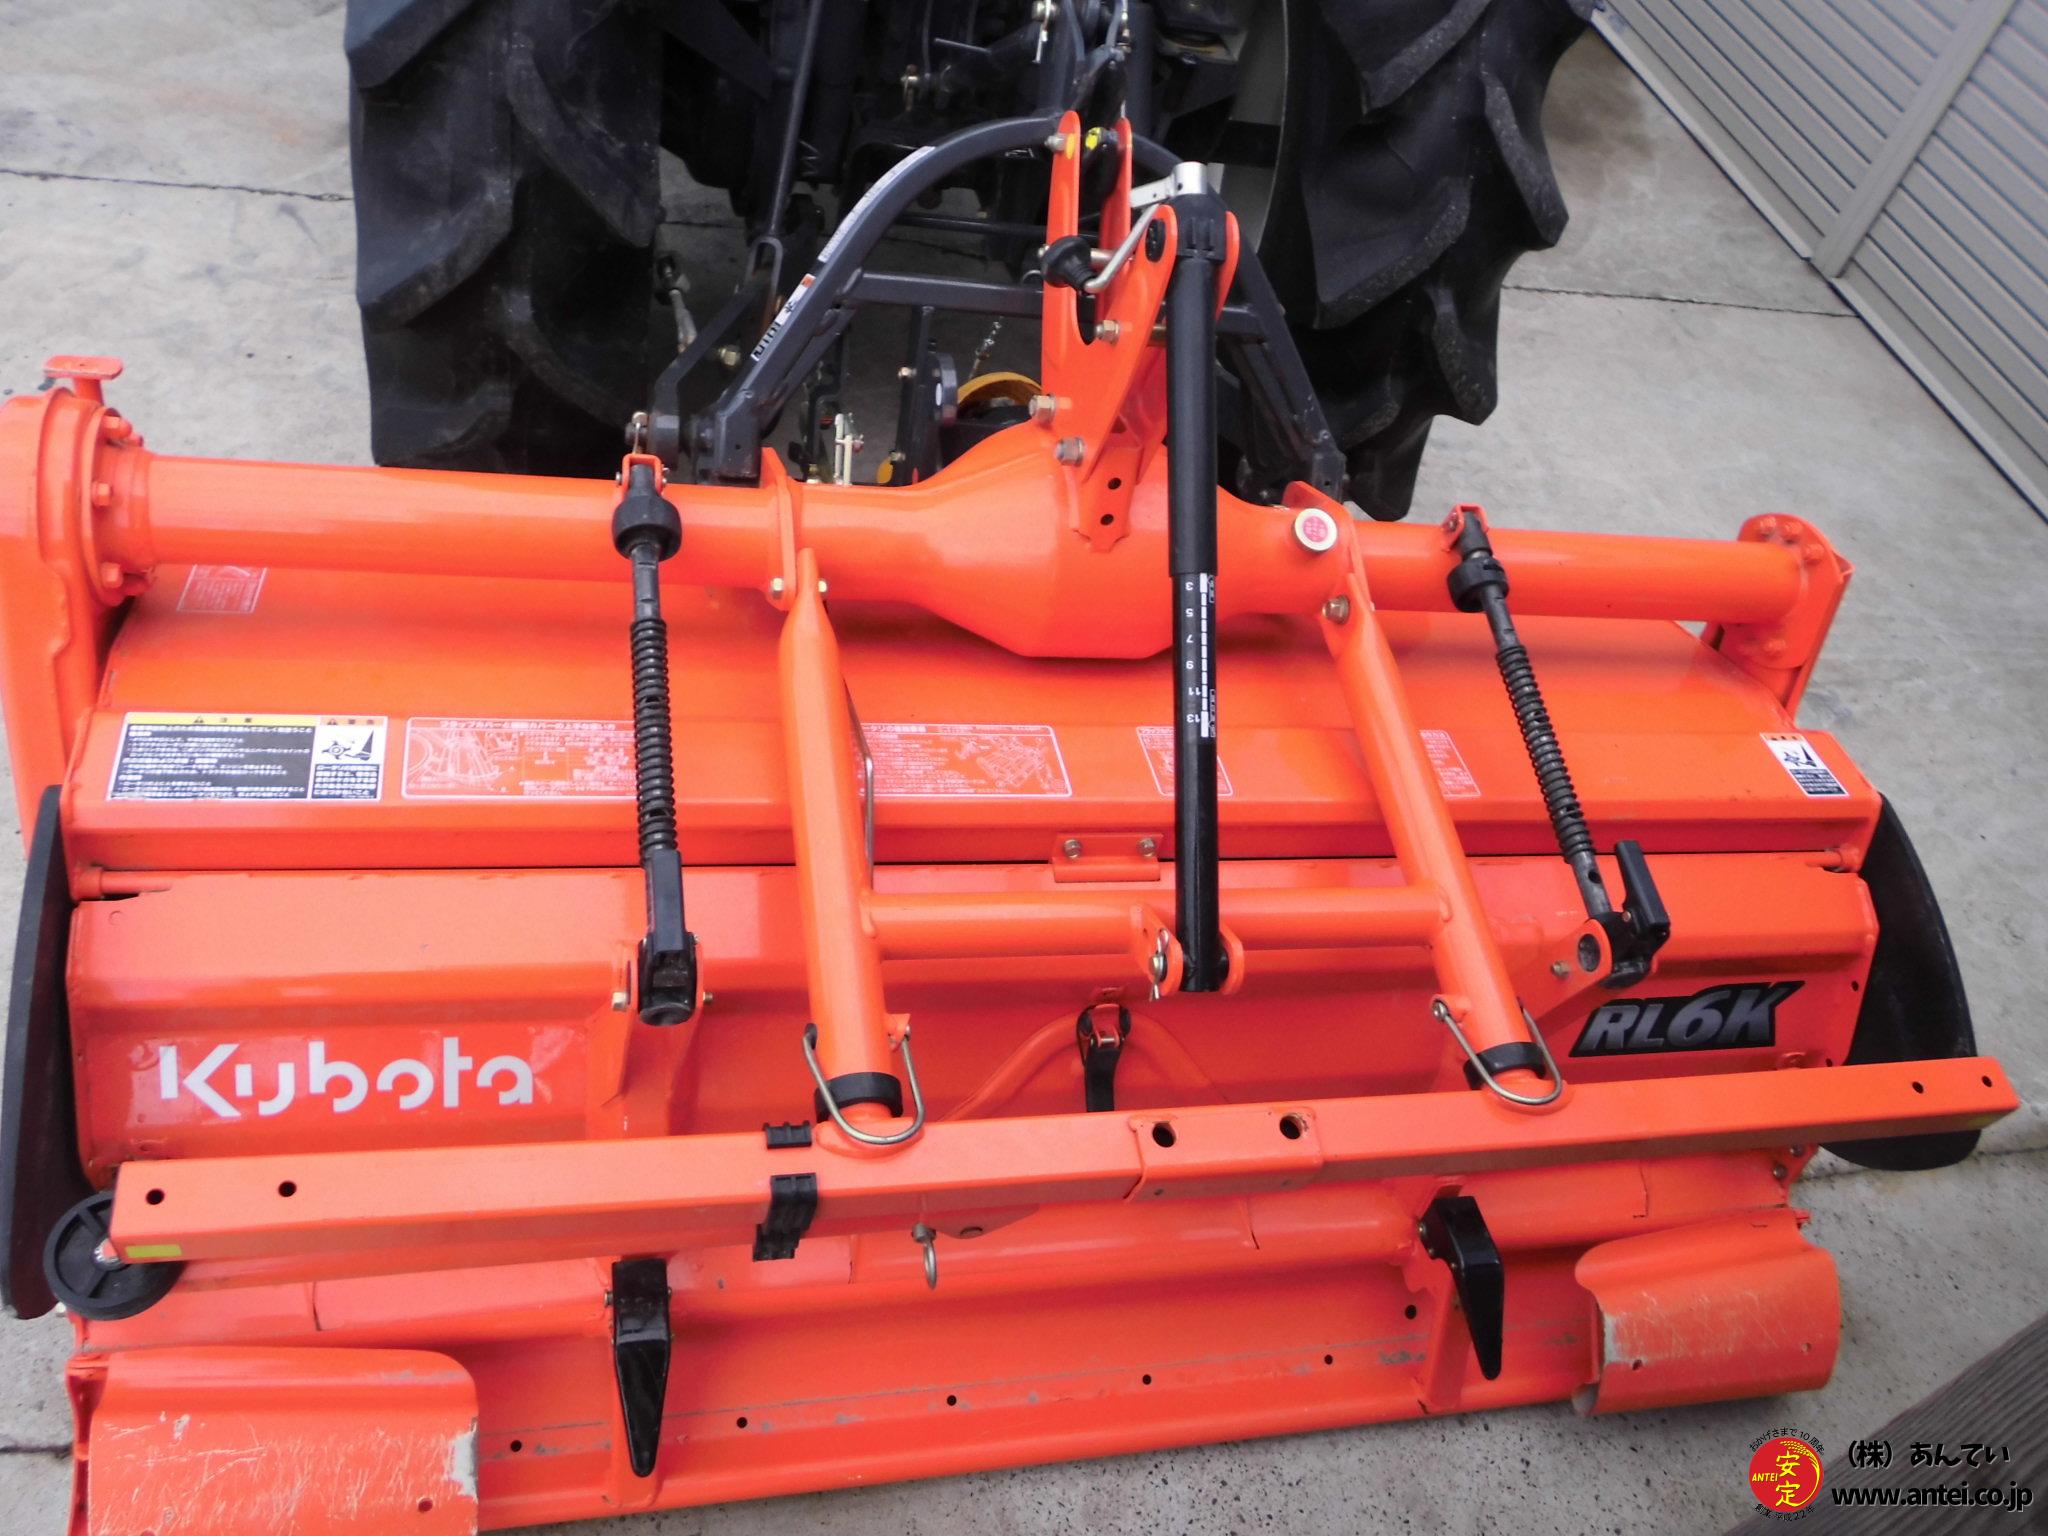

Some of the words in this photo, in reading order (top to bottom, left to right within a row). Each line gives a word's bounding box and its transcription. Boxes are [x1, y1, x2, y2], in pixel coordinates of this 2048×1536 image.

[1185, 582, 1194, 591] 3
[1185, 608, 1194, 617] 5
[1186, 634, 1194, 643] 7
[1188, 686, 1201, 696] 11
[1186, 713, 1200, 723] 13
[1577, 987, 1790, 1050] RL6K
[158, 1037, 535, 1118] Kubota
